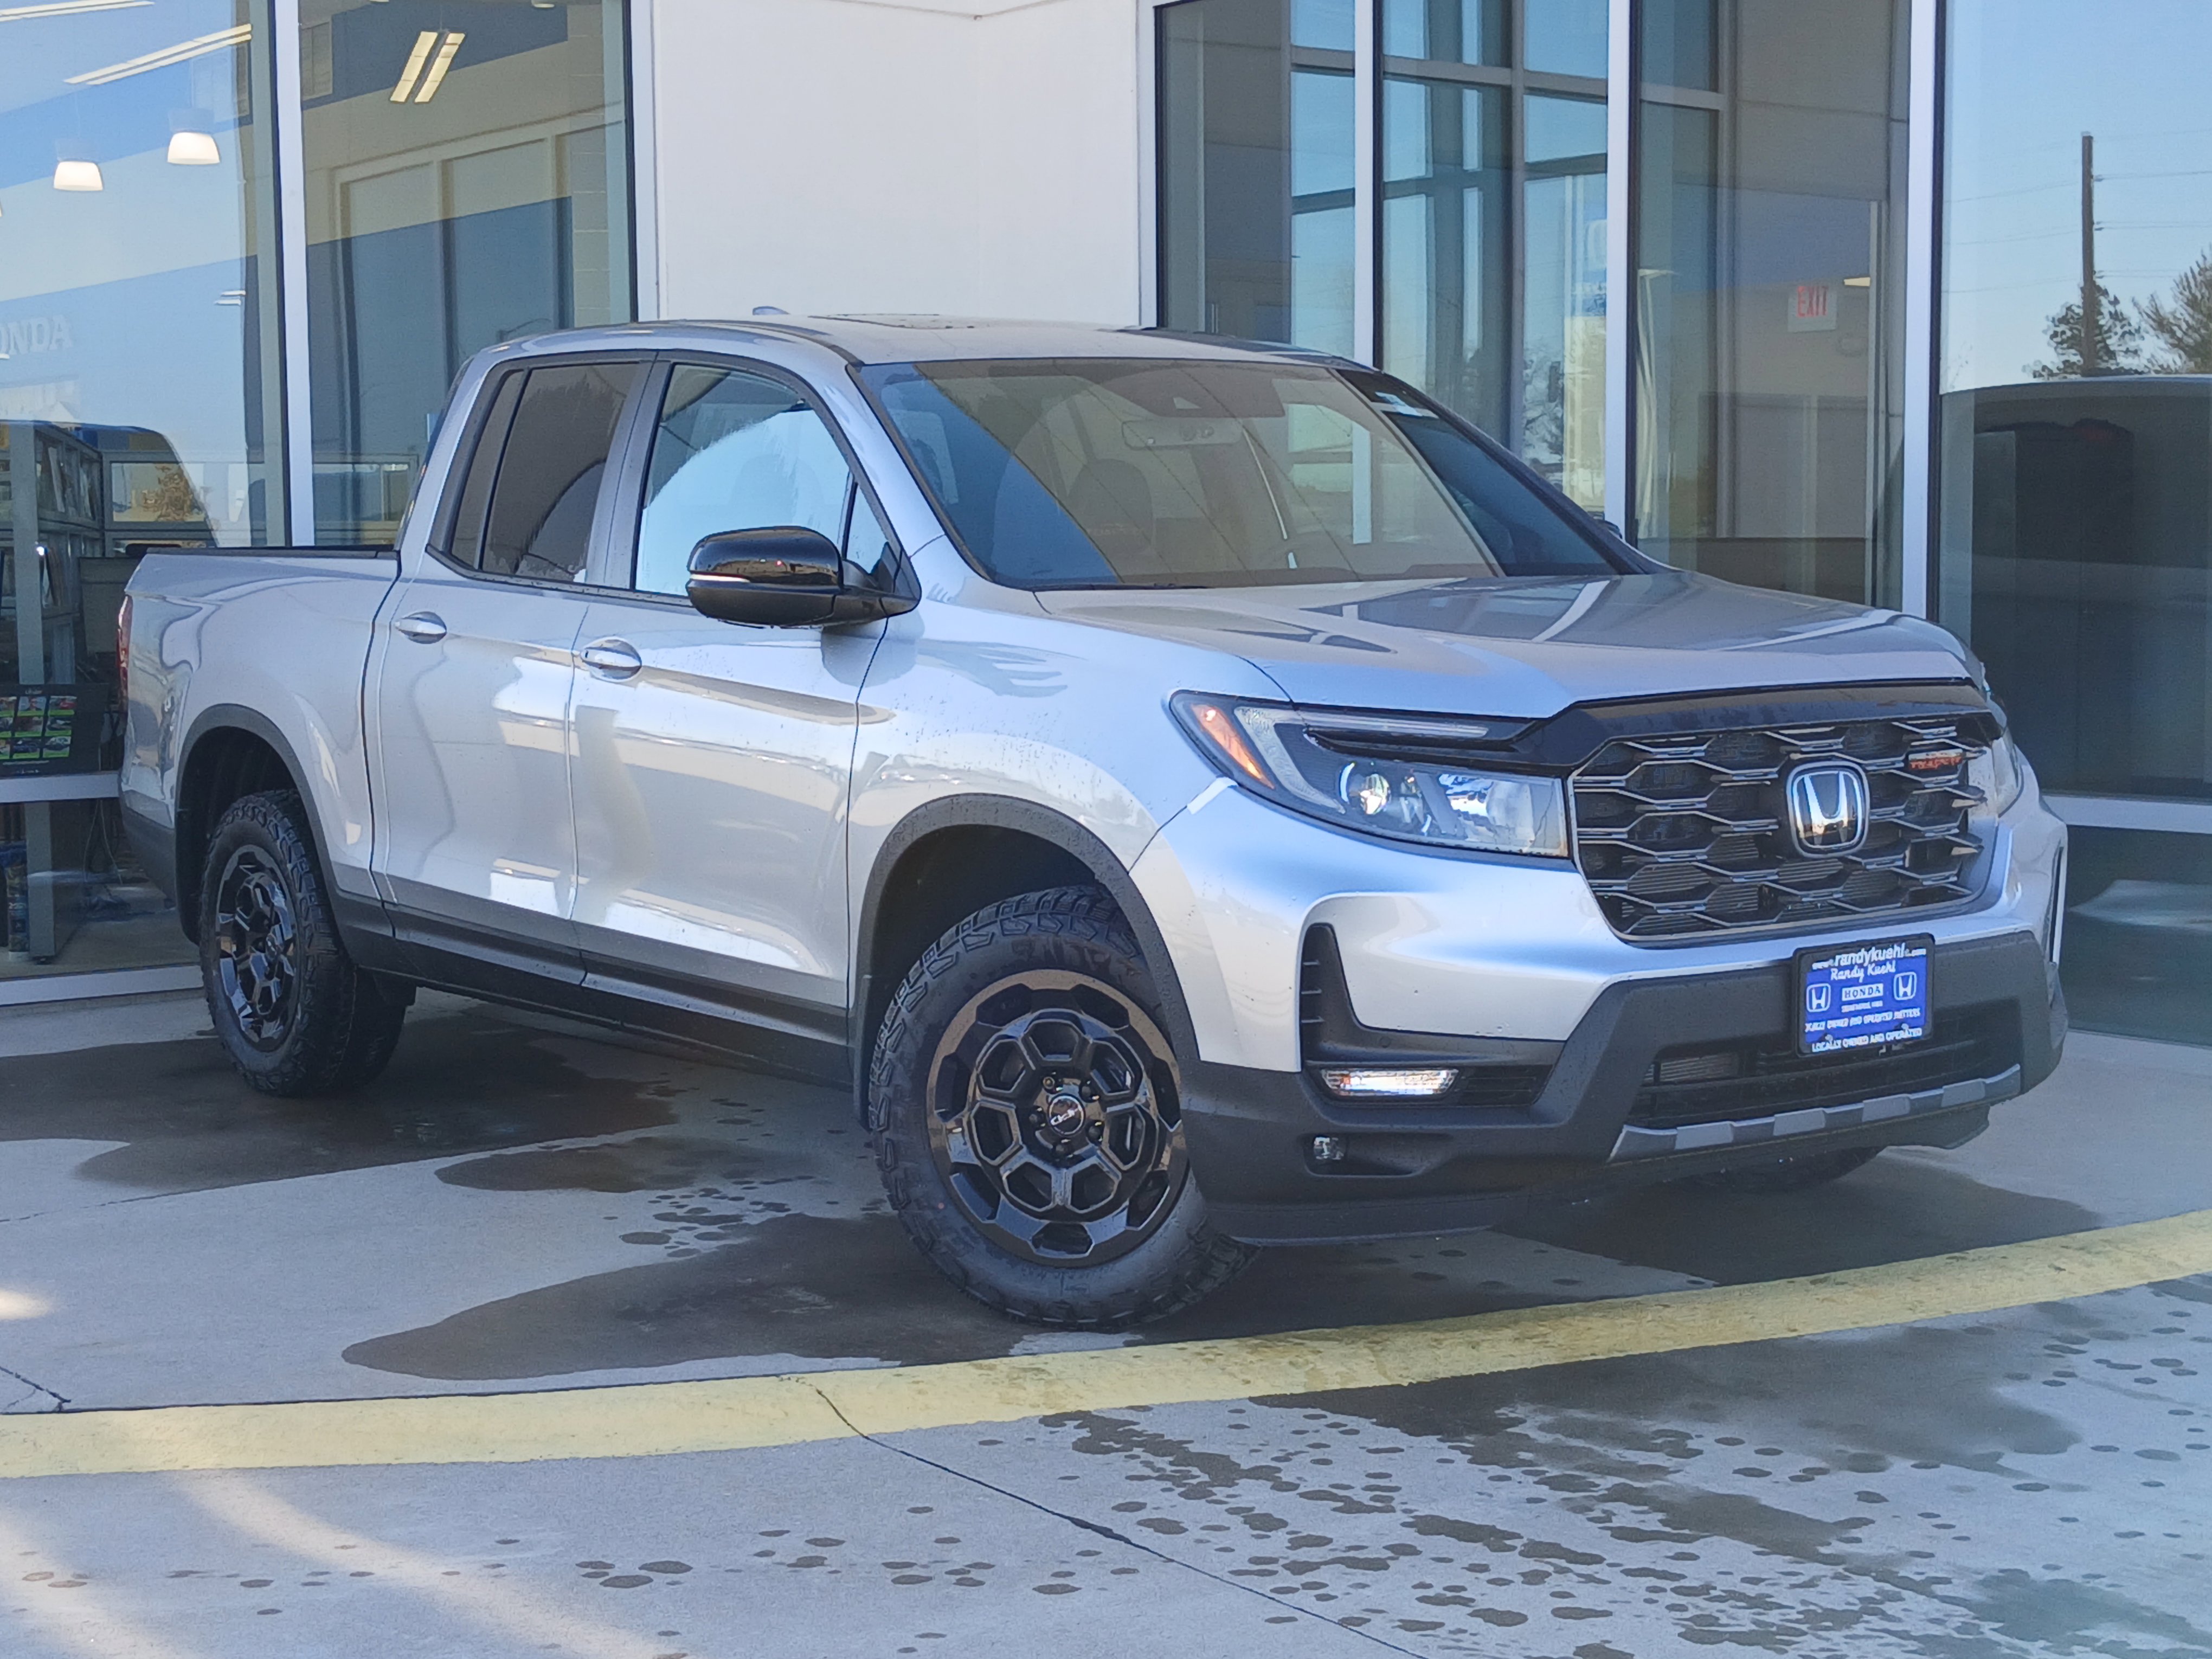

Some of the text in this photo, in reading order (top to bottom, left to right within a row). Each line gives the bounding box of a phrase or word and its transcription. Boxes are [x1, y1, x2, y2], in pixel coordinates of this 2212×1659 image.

[1797, 286, 1829, 318] EXIT
[1830, 960, 1896, 983] Randy Kuehl
[1844, 985, 1881, 999] HONDA
